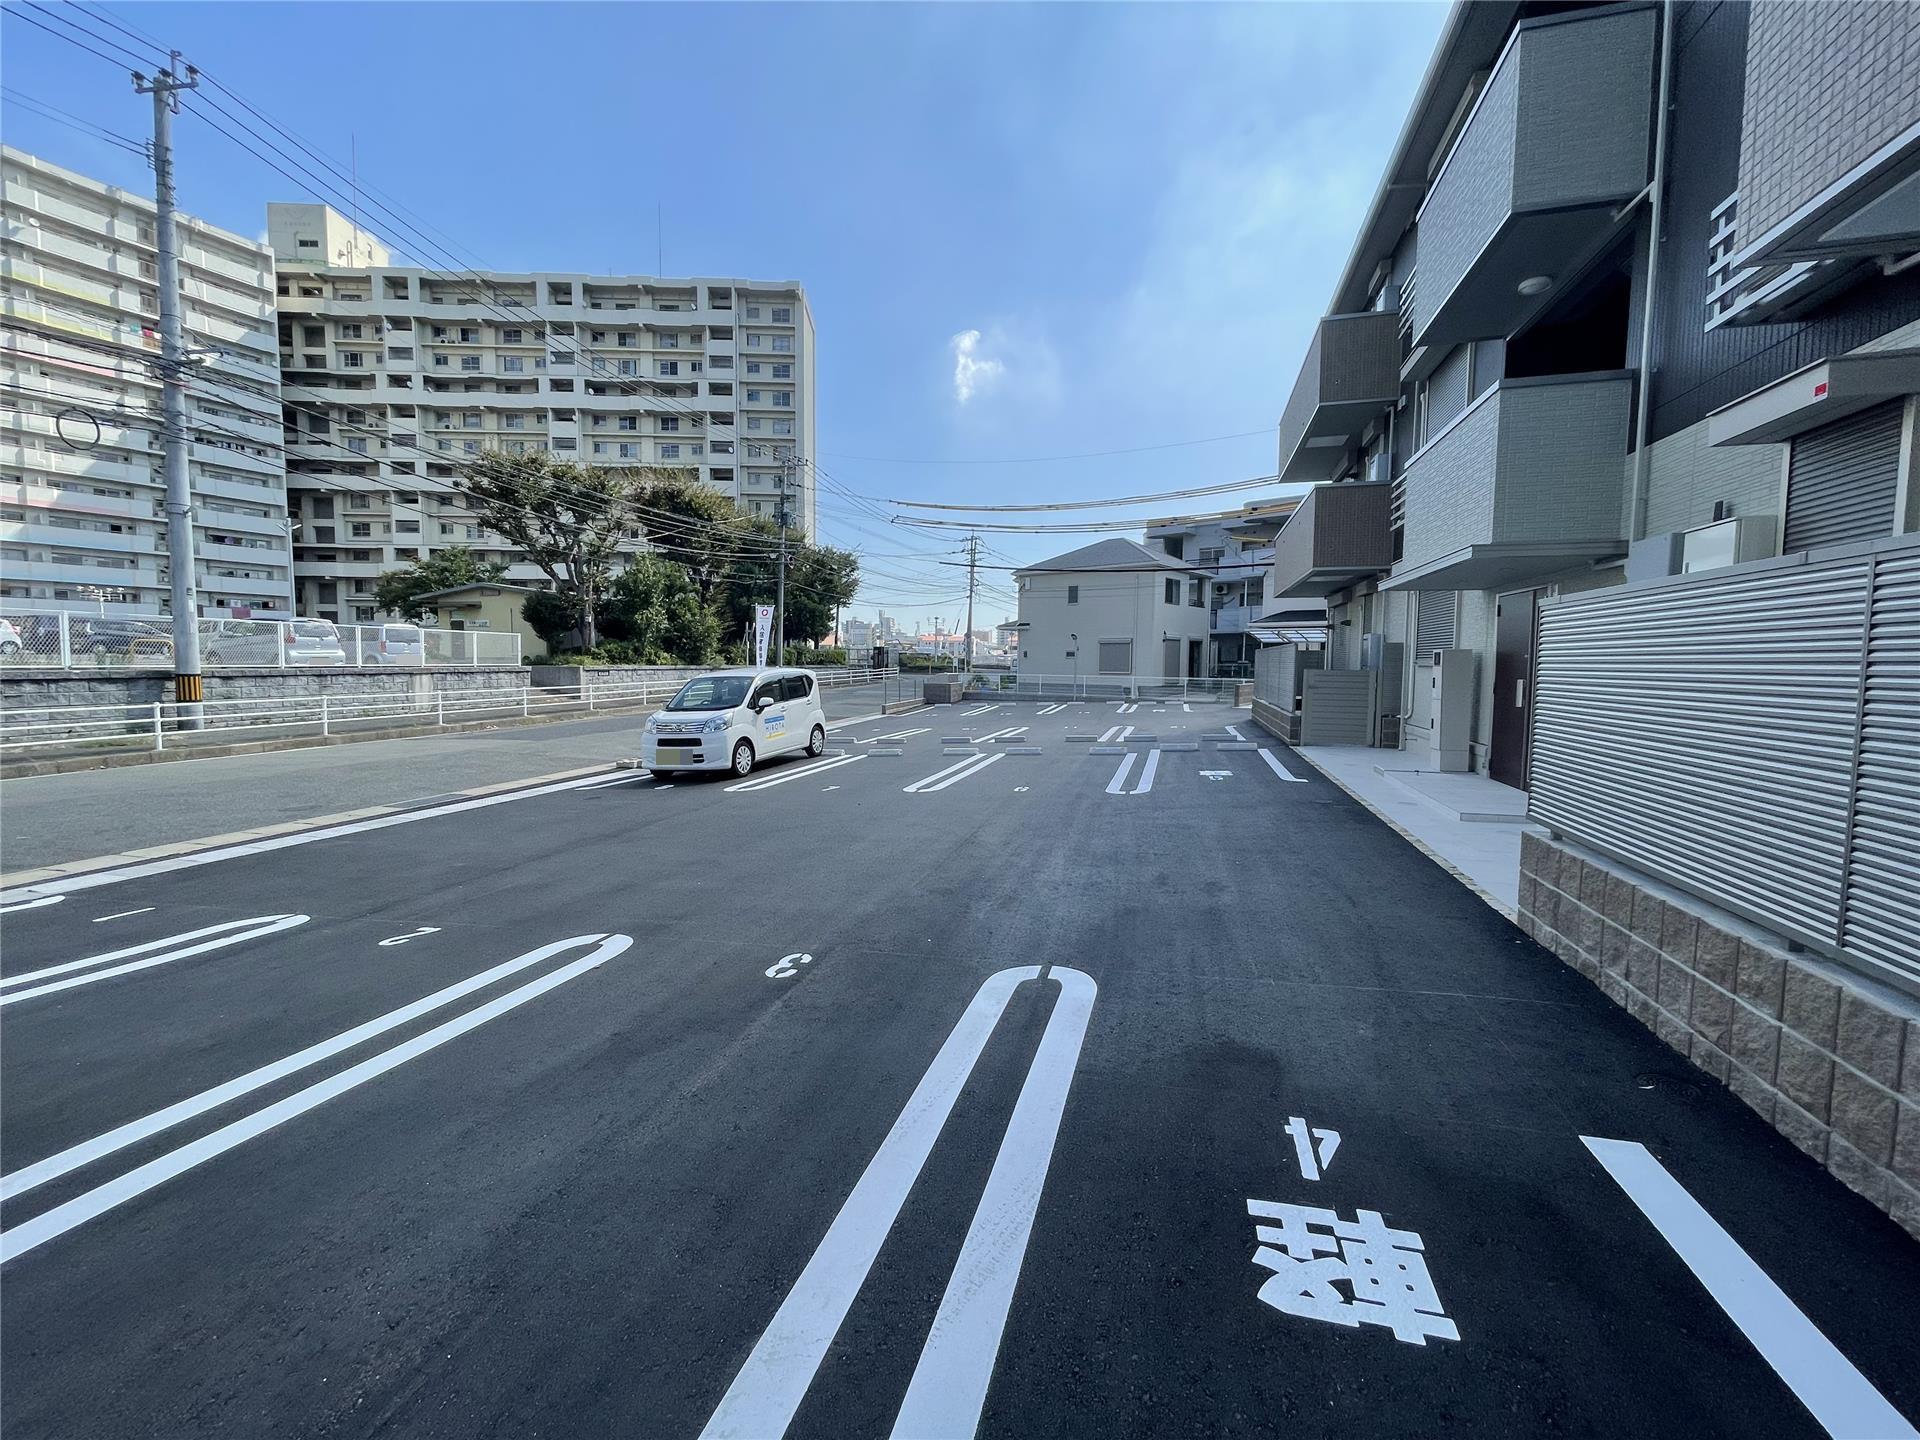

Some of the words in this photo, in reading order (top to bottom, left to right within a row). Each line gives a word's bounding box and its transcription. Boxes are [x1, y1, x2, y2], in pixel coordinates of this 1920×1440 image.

[377, 926, 442, 946] 2
[764, 952, 813, 978] 3
[1284, 1116, 1342, 1181] 4
[1246, 1198, 1462, 1346] 軽
